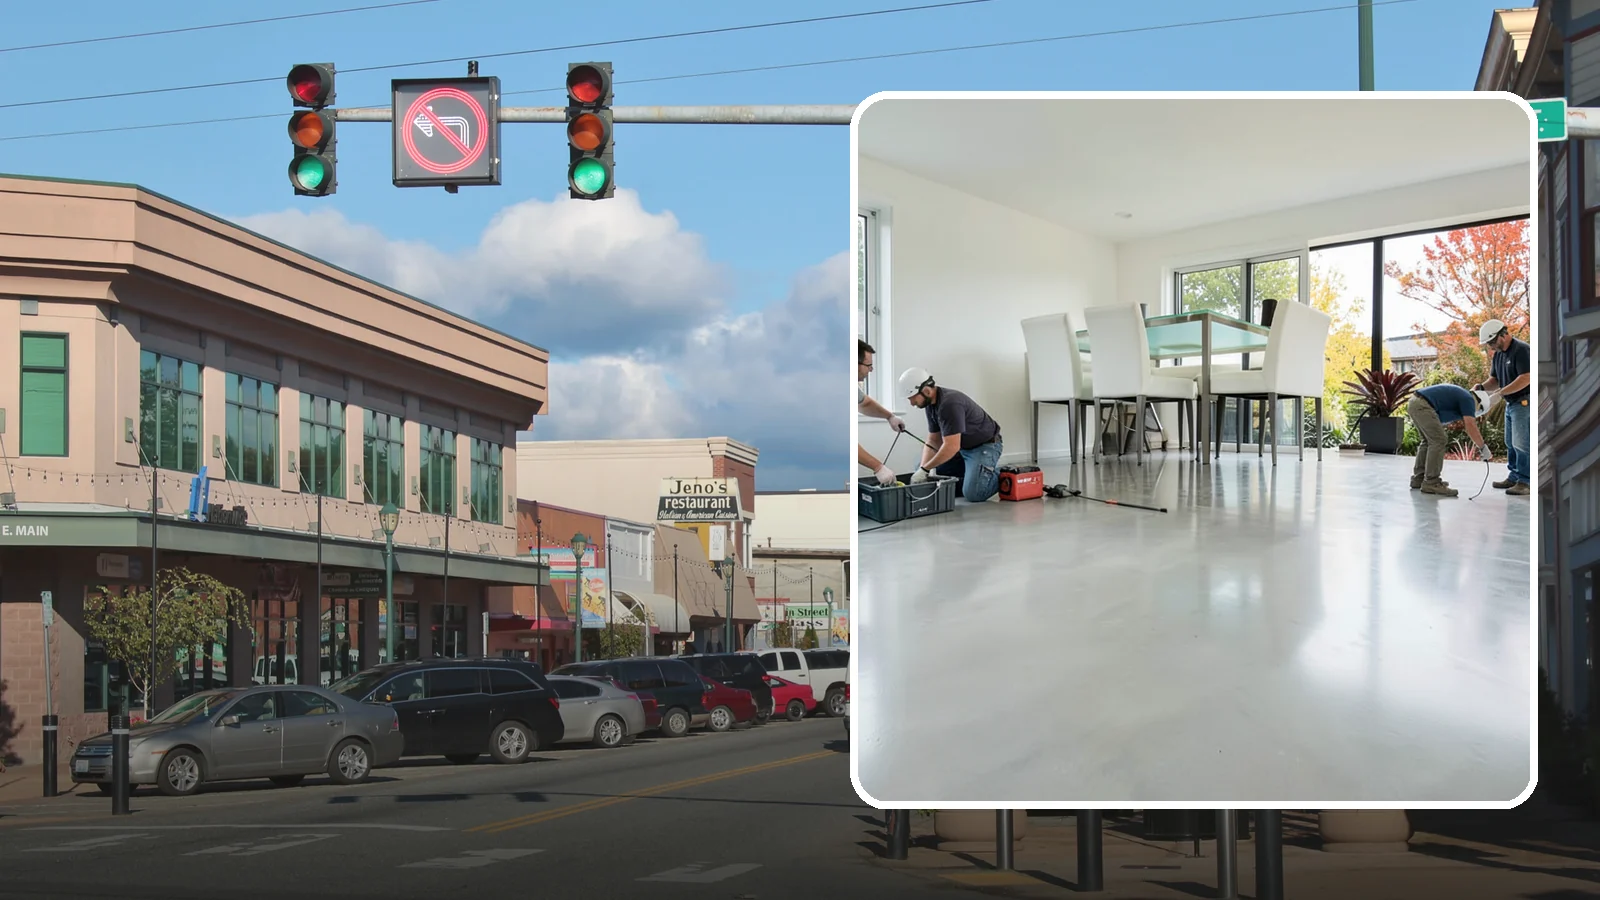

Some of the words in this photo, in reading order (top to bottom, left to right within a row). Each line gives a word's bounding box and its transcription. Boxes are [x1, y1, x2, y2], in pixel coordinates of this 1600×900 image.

[670, 480, 728, 495] Jeno's
[665, 496, 731, 509] restaurant
[658, 510, 681, 520] Italian
[685, 510, 714, 519] American
[714, 509, 738, 519] Cuisine
[2, 525, 13, 536] E.
[16, 525, 49, 536] MAIN
[797, 607, 828, 616] Street
